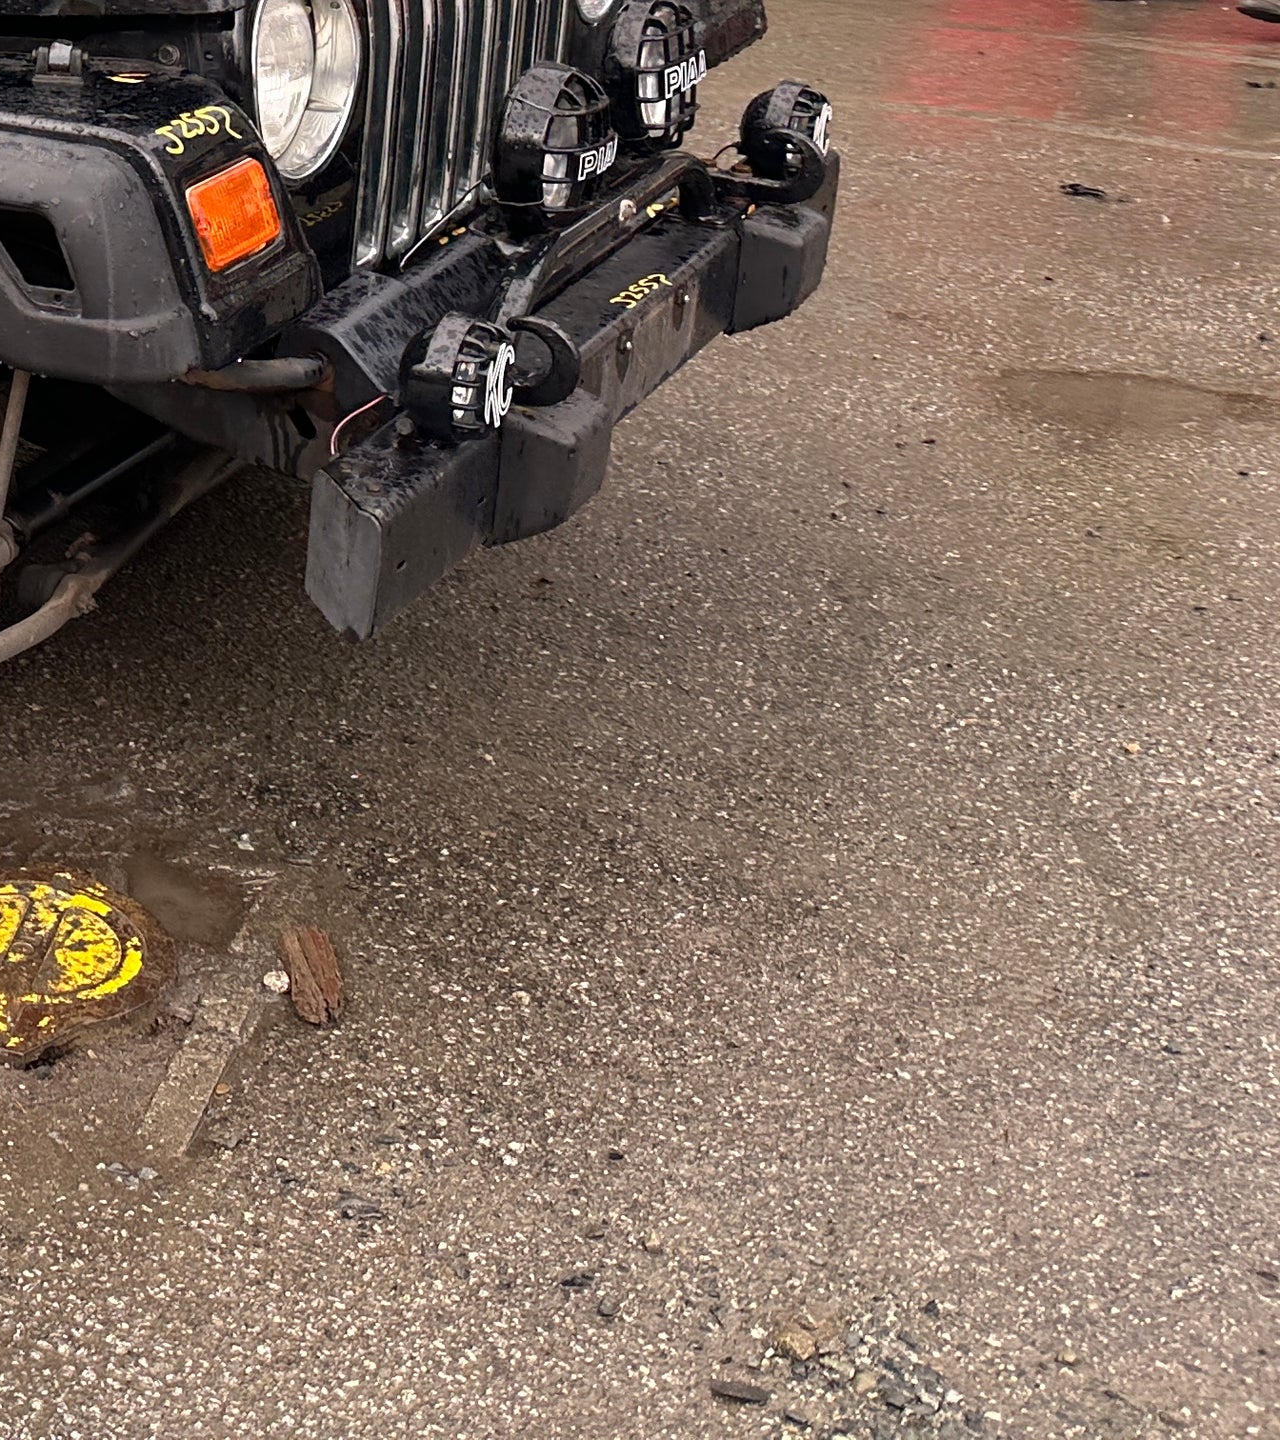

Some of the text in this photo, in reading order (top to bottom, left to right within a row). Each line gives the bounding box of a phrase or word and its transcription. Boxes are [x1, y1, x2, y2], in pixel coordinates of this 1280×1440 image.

[664, 49, 708, 100] PIAA
[154, 105, 243, 155] J2552
[609, 273, 673, 309] J2552
[484, 342, 516, 429] KC
